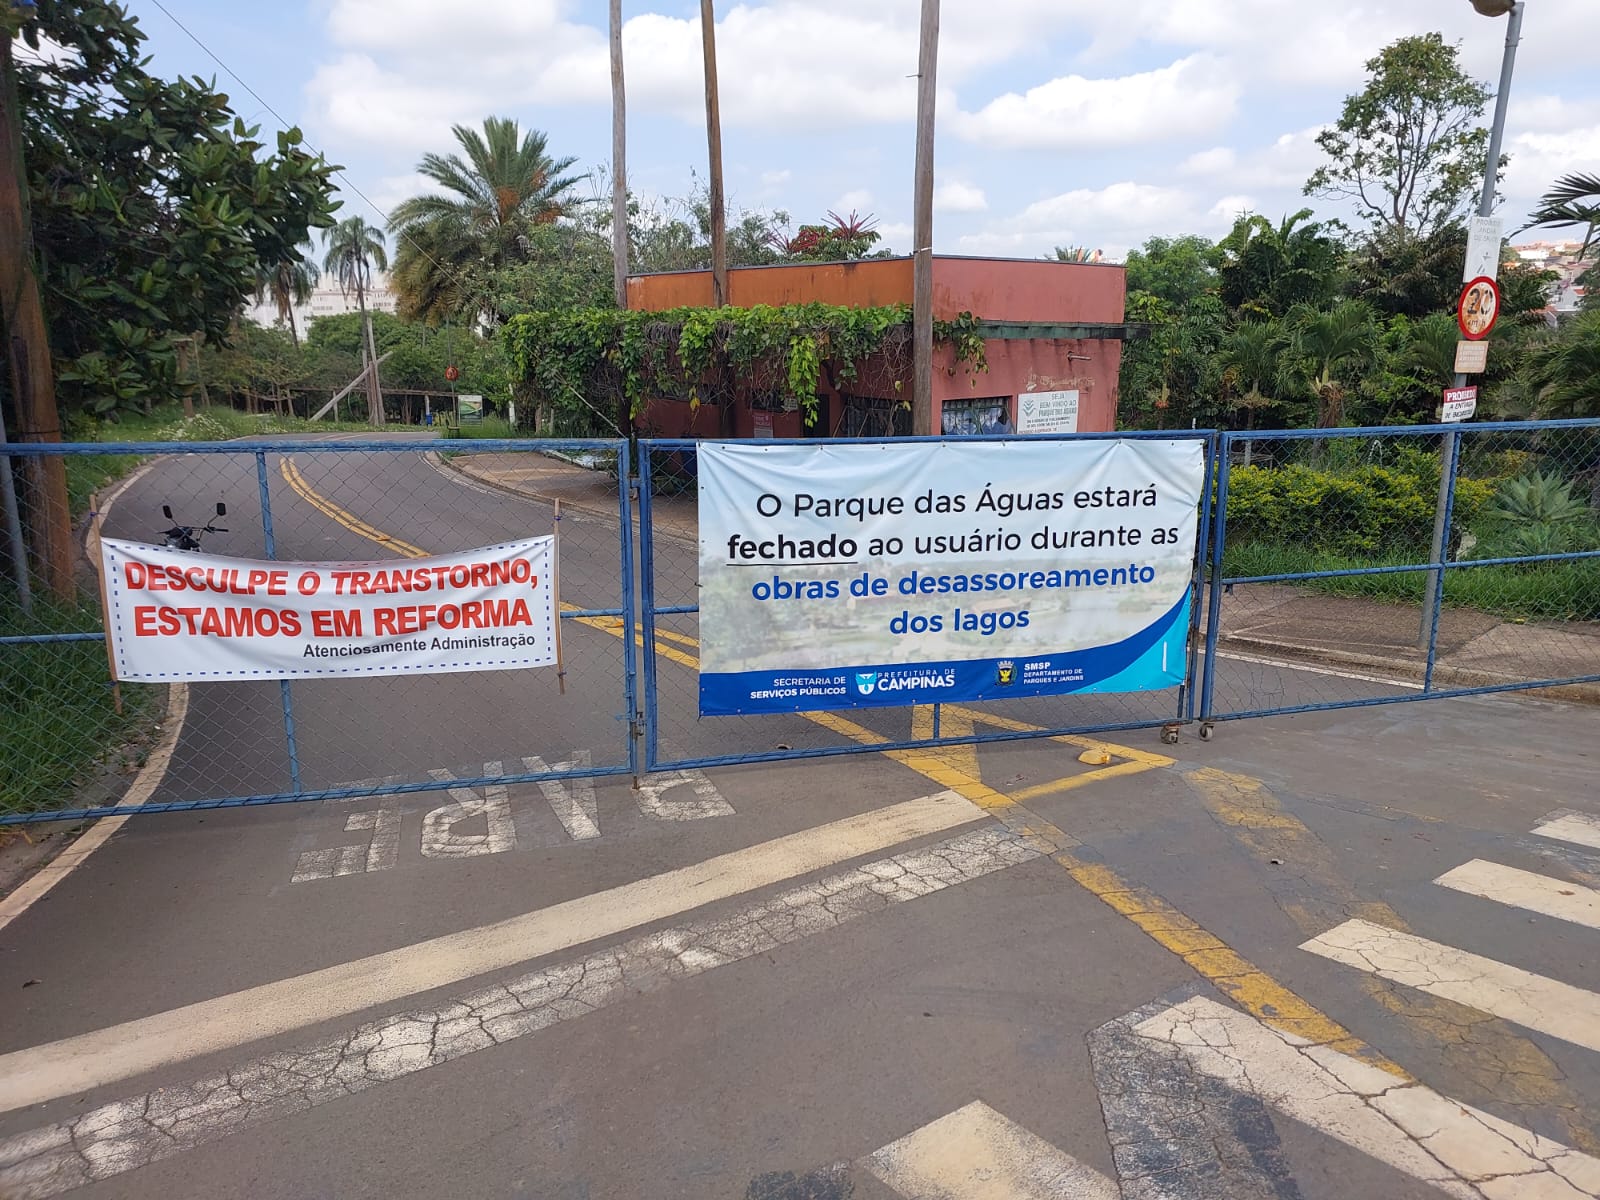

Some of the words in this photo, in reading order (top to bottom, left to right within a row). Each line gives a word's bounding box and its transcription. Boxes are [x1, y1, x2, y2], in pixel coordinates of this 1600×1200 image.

[756, 493, 782, 517] O
[794, 493, 904, 522] Parque
[914, 489, 966, 514] das
[975, 482, 1064, 517] Águas
[1073, 483, 1157, 509] estará
[728, 533, 858, 559] fechado
[869, 537, 903, 556] ao
[915, 527, 1021, 554] usuário
[1031, 525, 1141, 550] durante
[1151, 527, 1179, 545] as
[124, 561, 287, 596] DESCULPE
[299, 571, 320, 596] O
[331, 557, 539, 597] TRANSTORNO,
[752, 575, 840, 601] obras
[850, 572, 889, 597] de
[898, 563, 1155, 595] desassoreamento
[134, 605, 302, 638] ESTAMOS
[312, 608, 362, 638] EM
[374, 598, 533, 637] REFORMA
[889, 610, 943, 634] dos
[954, 608, 1030, 636] lagos
[303, 639, 427, 659] Atenciosamente
[430, 633, 536, 652] Administração
[877, 669, 938, 678] PREFEITURA
[1023, 669, 1073, 678] DEPARTAMENTO
[1024, 662, 1051, 671] SMSP
[750, 688, 798, 699] SERVIÇOS
[799, 686, 847, 696] PÚBLICOS
[773, 677, 831, 687] SECRETARIA
[833, 676, 846, 685] DE
[877, 674, 955, 691] CAMPINAS
